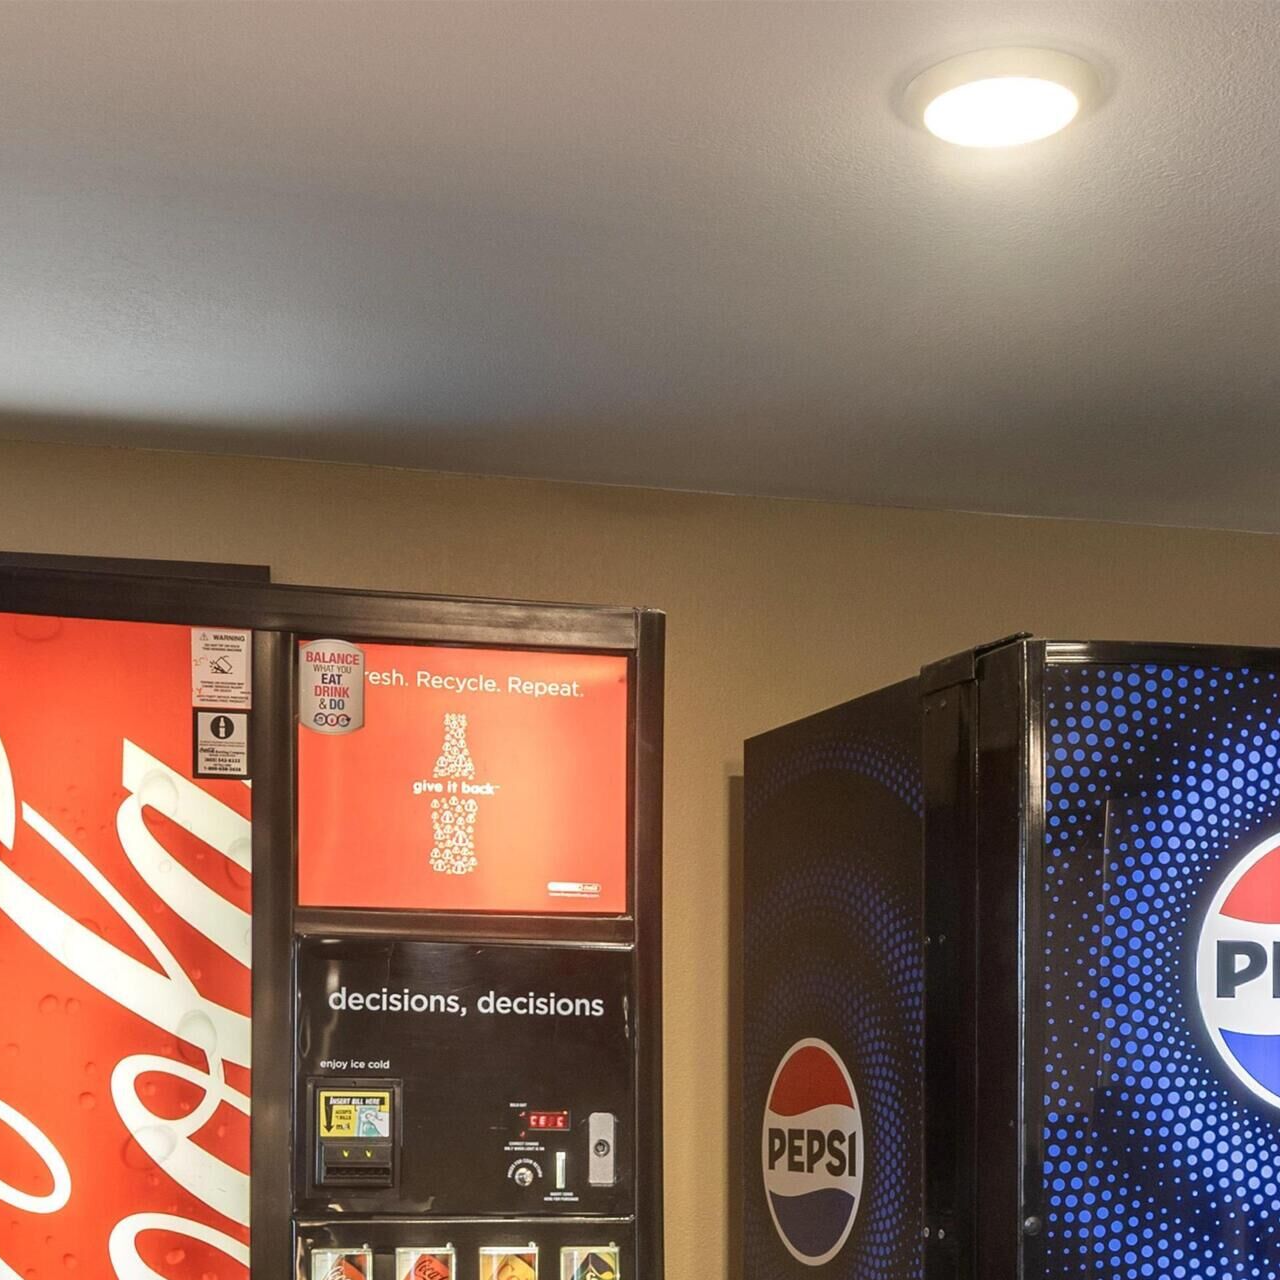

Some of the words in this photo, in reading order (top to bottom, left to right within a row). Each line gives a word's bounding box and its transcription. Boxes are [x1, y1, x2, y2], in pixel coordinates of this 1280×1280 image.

[213, 634, 245, 642] WARNING
[306, 651, 360, 665] BALANCE
[313, 664, 334, 673] WHAT
[337, 665, 352, 674] YOU
[416, 670, 501, 693] Recycle.
[508, 676, 584, 697] Repeat.
[314, 685, 350, 698] DRINK
[319, 698, 327, 710] &
[329, 699, 345, 710] DO
[413, 779, 443, 795] give
[447, 781, 458, 793] it
[328, 987, 468, 1016] decisions,
[477, 990, 605, 1016] decisions
[320, 1059, 348, 1070] enjoy
[350, 1059, 366, 1068] ice
[368, 1060, 390, 1069] cold
[330, 1096, 350, 1105] INSERT
[768, 1128, 856, 1177] PEPSI
